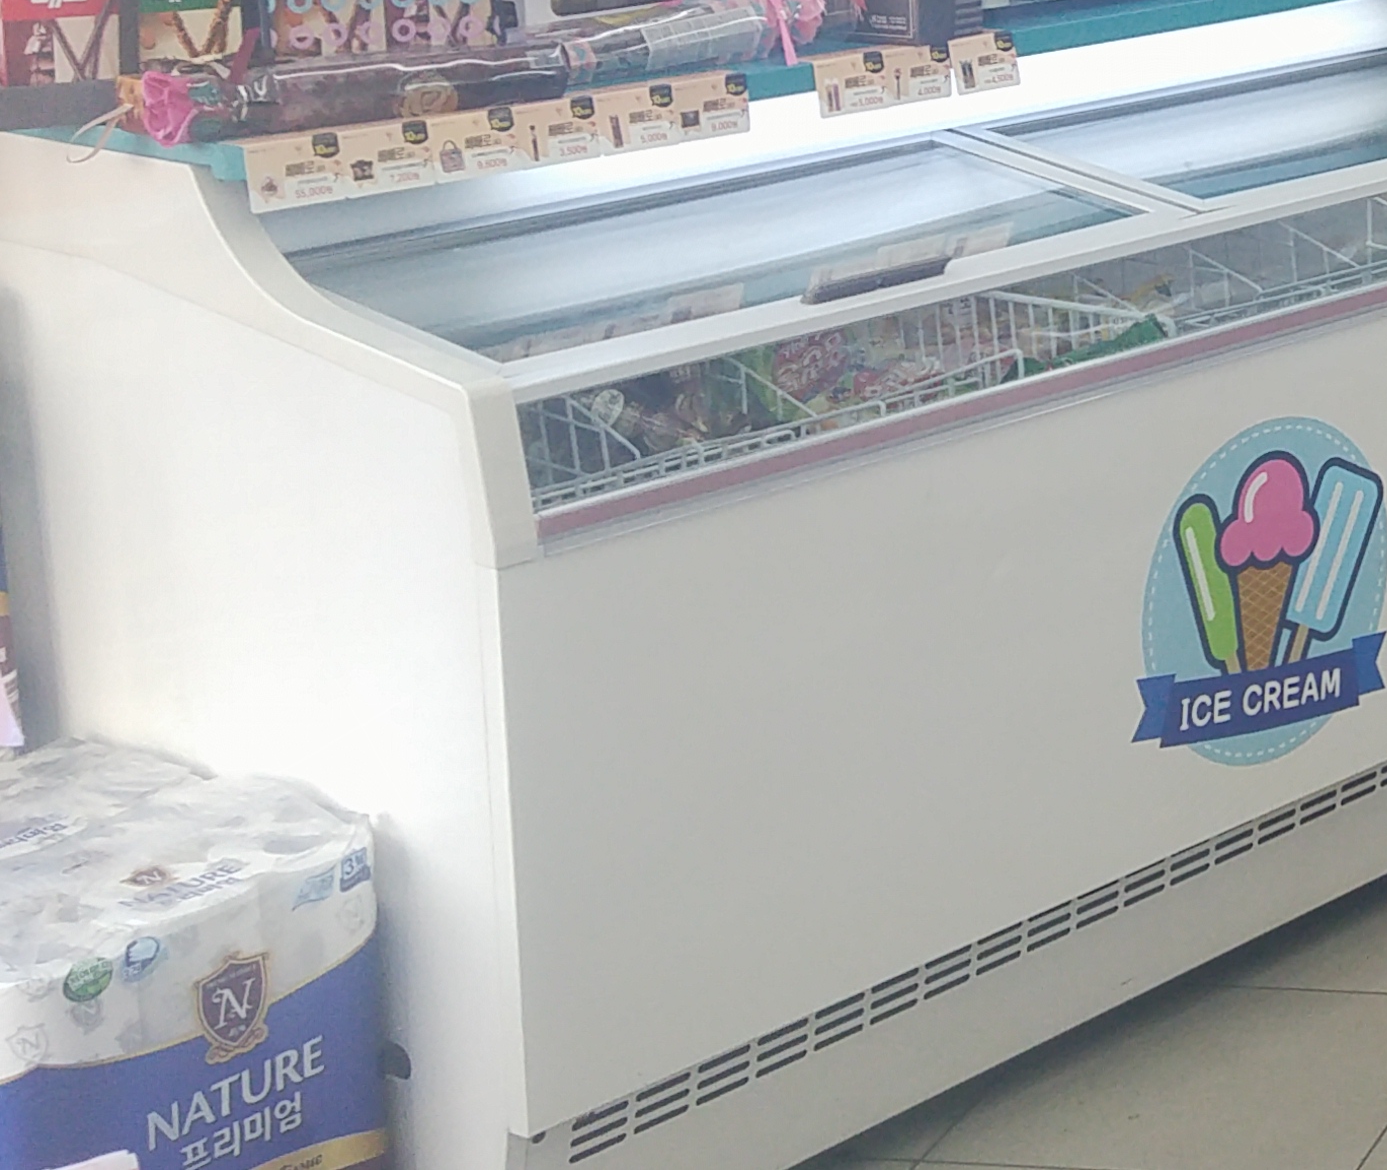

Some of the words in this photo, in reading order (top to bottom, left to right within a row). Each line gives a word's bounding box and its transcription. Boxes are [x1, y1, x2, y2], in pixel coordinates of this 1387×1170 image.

[1179, 689, 1231, 732] ICE
[1242, 667, 1342, 716] CREAM
[147, 1035, 325, 1151] NATURE
[179, 1091, 303, 1170] 프리미엄
